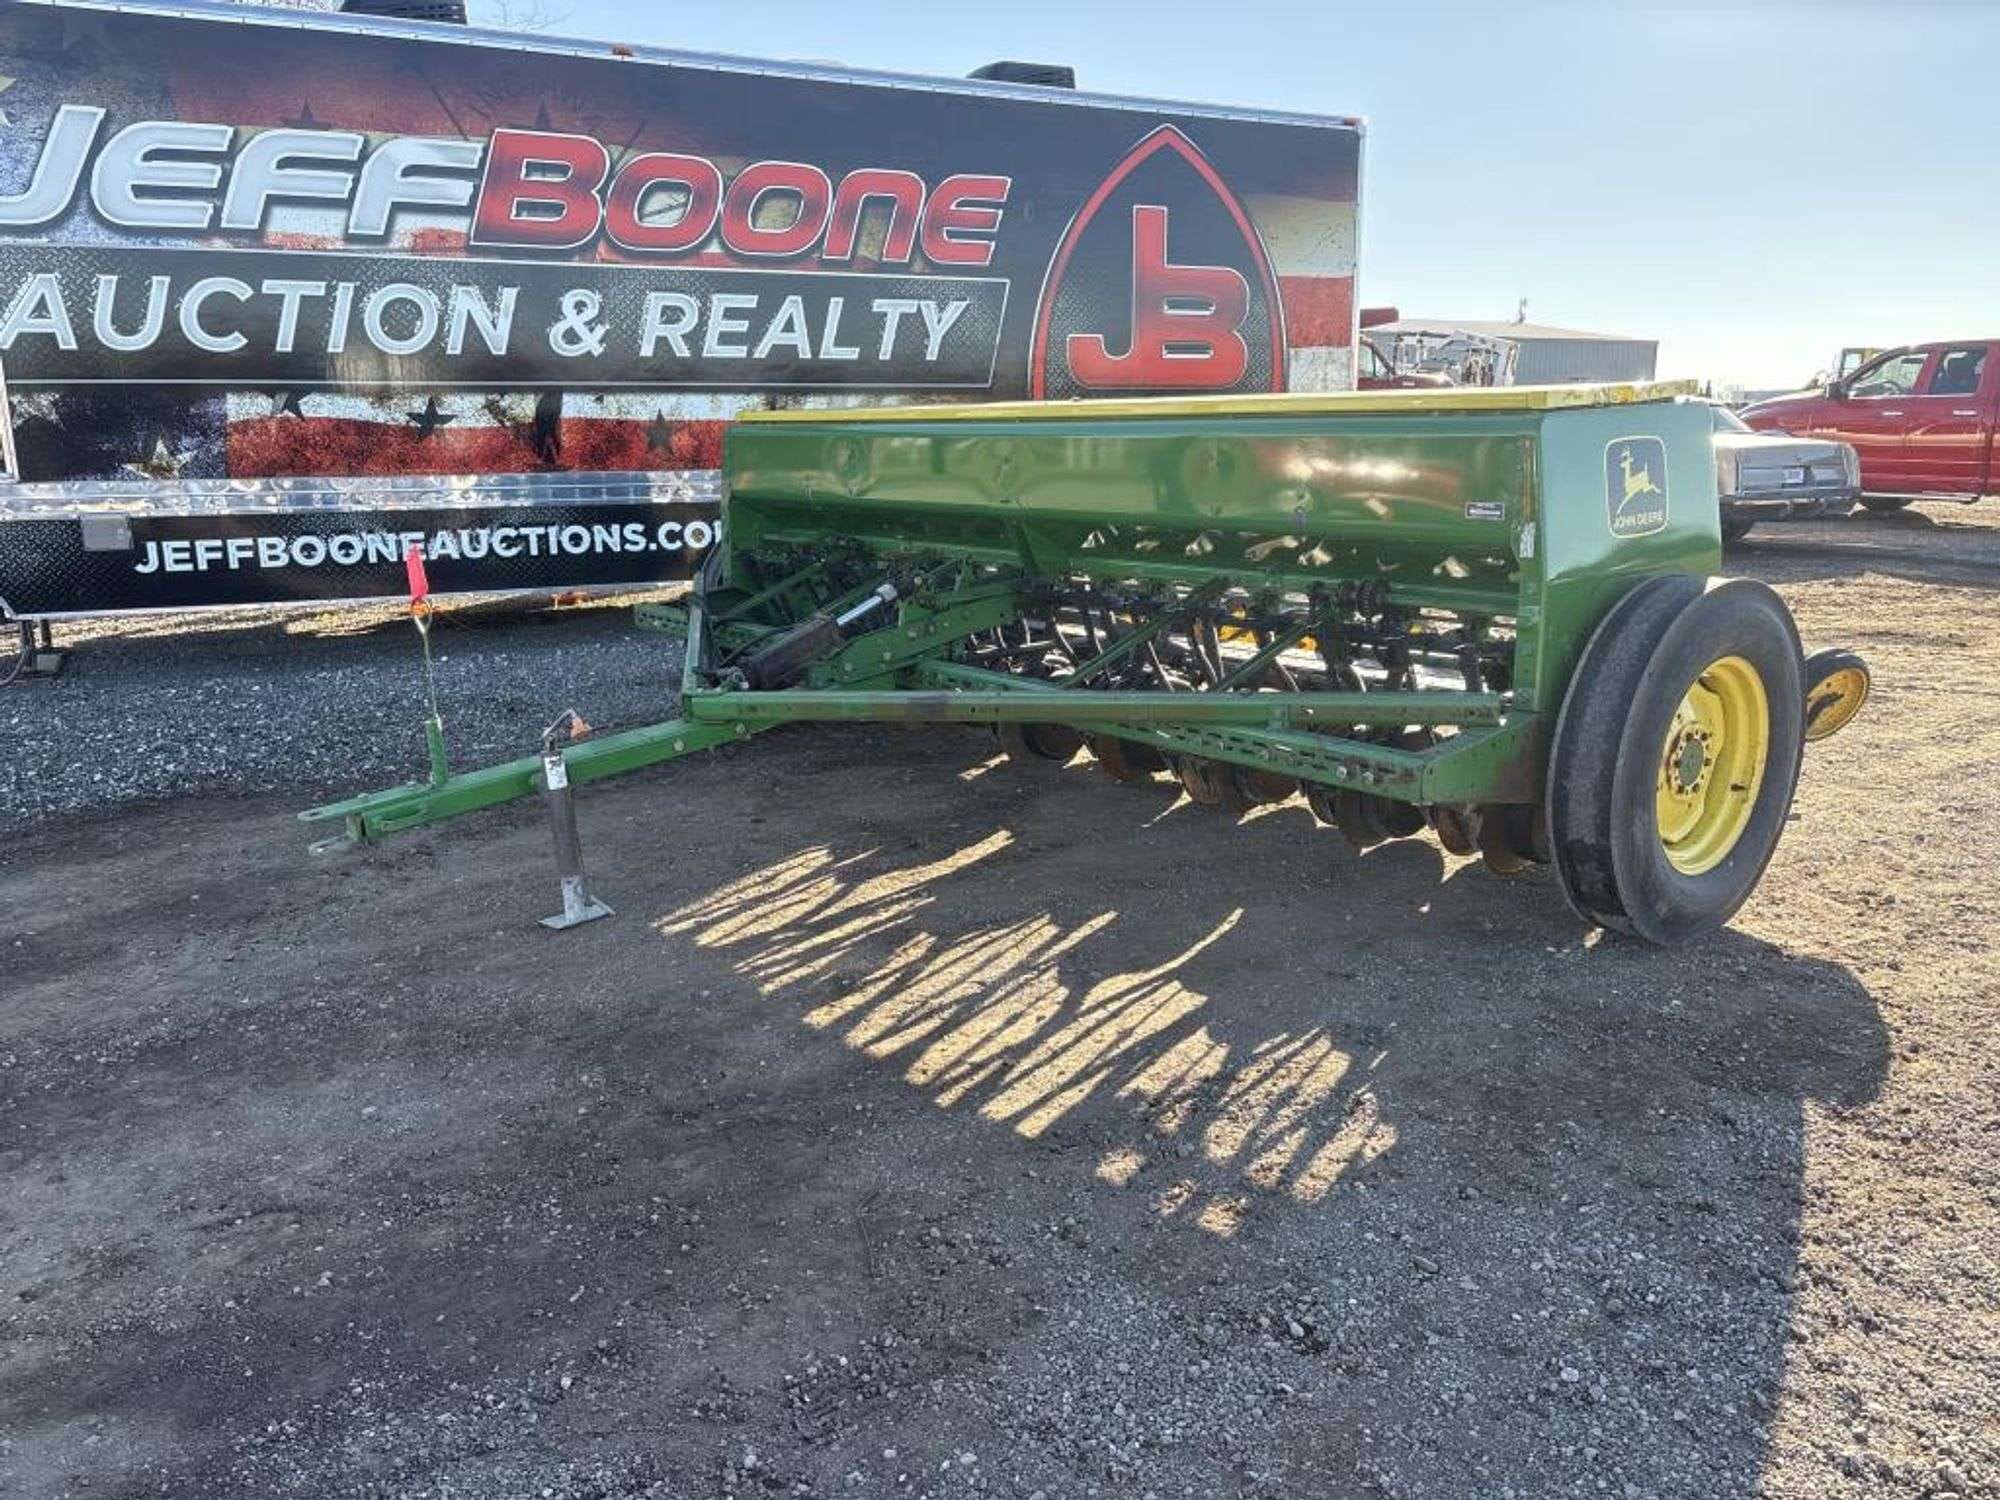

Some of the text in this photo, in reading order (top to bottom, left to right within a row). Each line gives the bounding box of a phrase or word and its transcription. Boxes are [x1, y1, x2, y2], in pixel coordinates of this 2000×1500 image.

[0, 272, 969, 362] AUCTION & REALTY
[1613, 510, 1664, 529] JOHN DEERE
